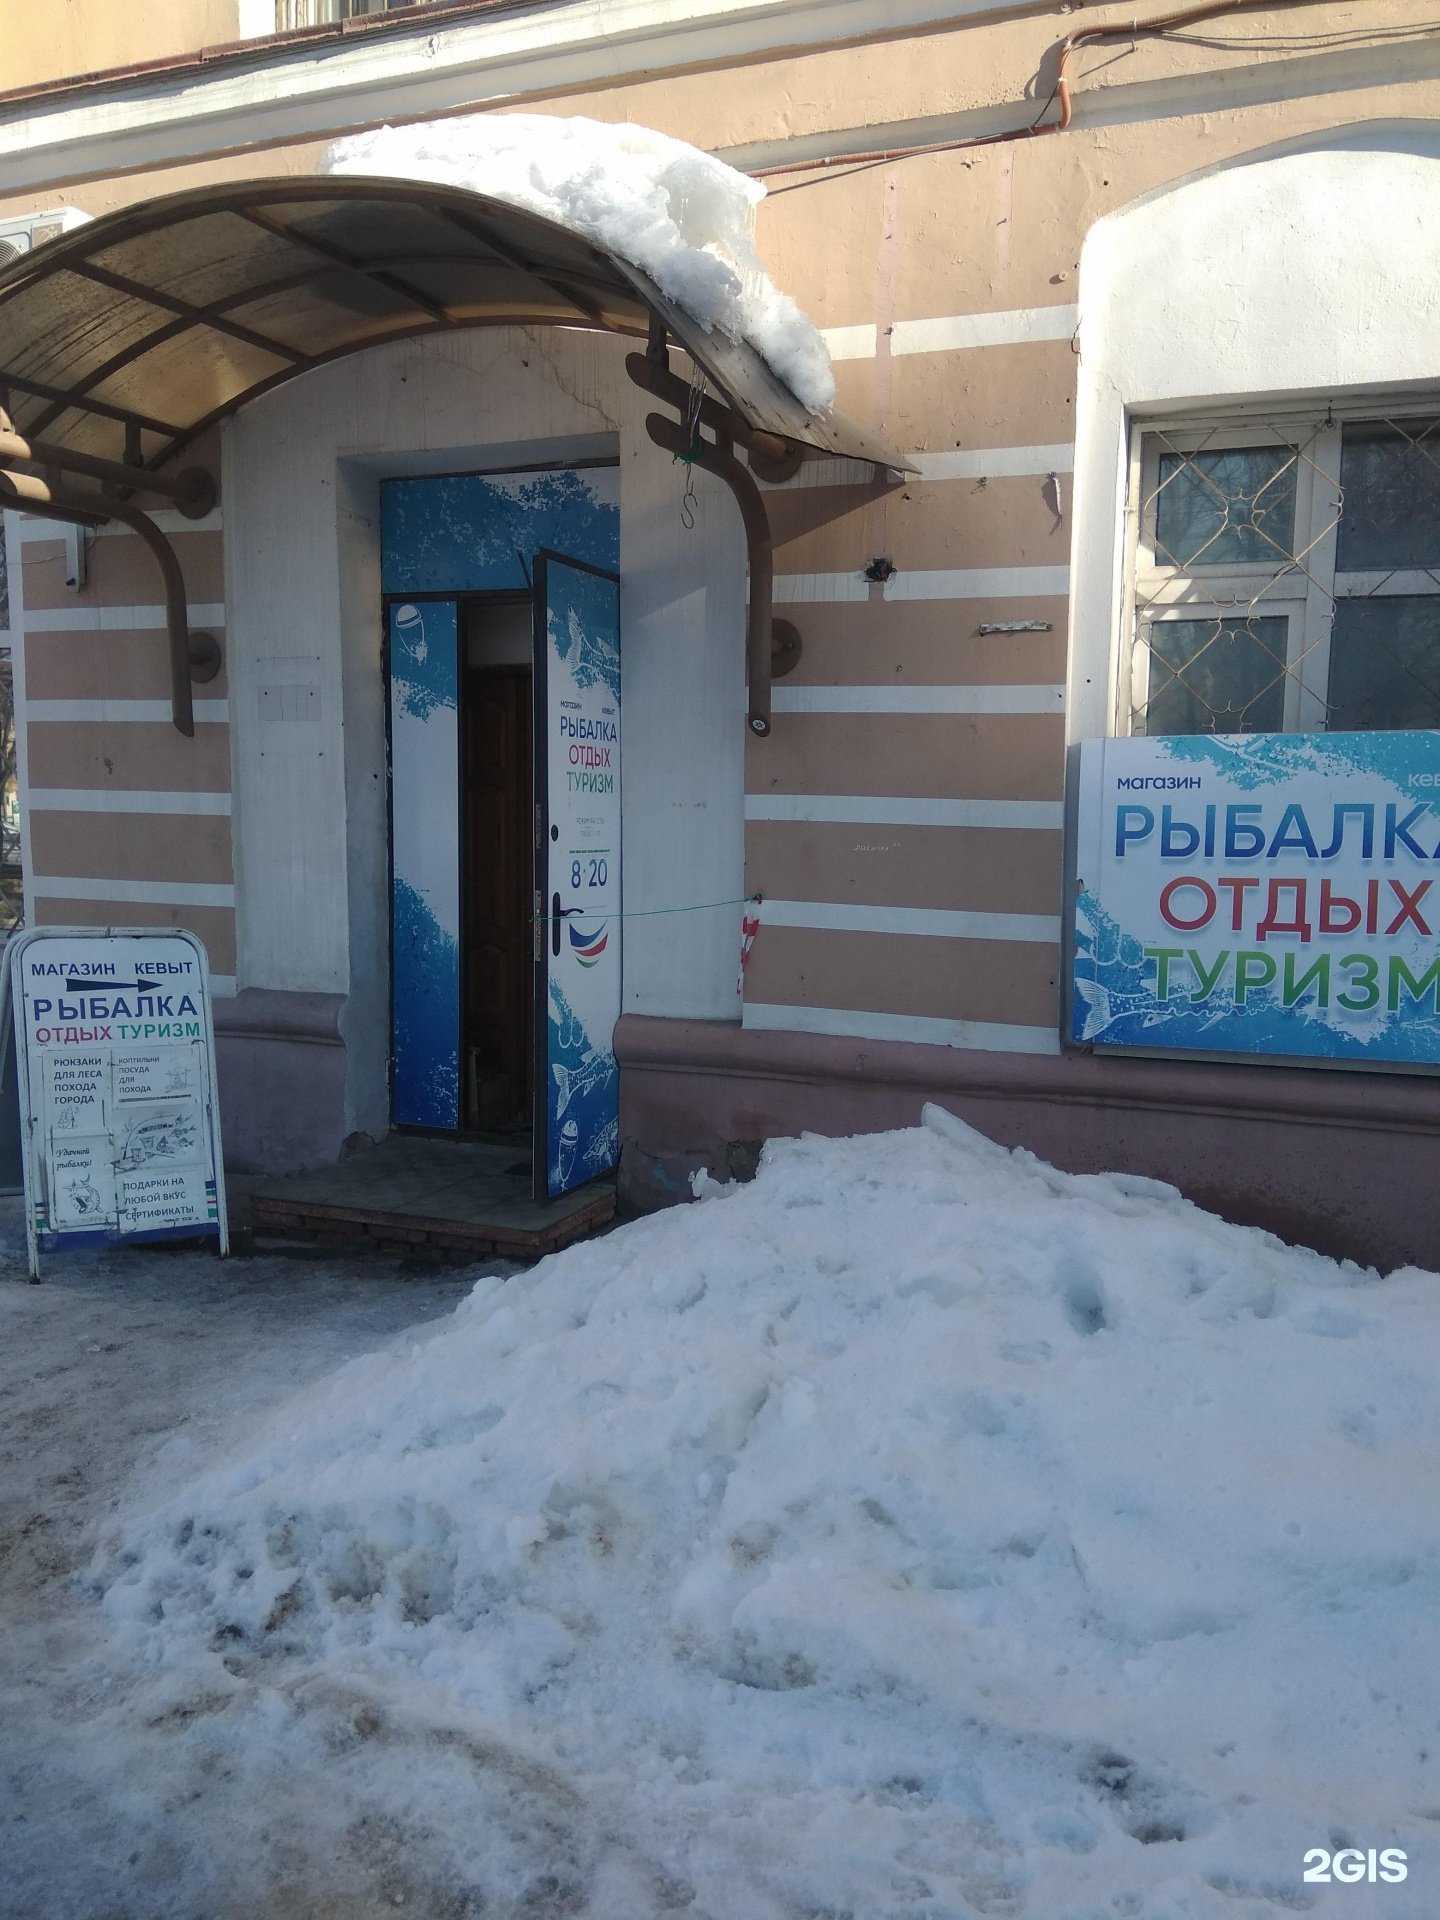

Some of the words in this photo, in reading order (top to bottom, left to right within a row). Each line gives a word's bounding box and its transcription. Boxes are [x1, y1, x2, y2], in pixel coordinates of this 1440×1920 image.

[560, 716, 617, 742] РЫБАЛКА
[569, 745, 611, 769] ОТДЫХ
[566, 771, 614, 793] ТУРИЗМ
[1117, 776, 1201, 790] магазин
[1115, 803, 1440, 859] РЫБАЛК
[1159, 876, 1434, 943] ОТДЫХ
[31, 963, 115, 976] МАГАЗИН
[134, 961, 192, 975] КЕВЫТ
[1144, 948, 1440, 1014] ТУРИЗМ
[33, 995, 198, 1021] РЫБАЛКА
[36, 1025, 112, 1045] ОТДЫХ
[117, 1022, 201, 1040] ТУРИЗМ
[54, 1057, 102, 1067] РЮКЗАКИ
[54, 1071, 75, 1081] ДЛЯ
[77, 1070, 103, 1079] ЛЕСА
[119, 1066, 150, 1074] ПОСУДА
[54, 1083, 97, 1093] ПОХОДА
[119, 1085, 152, 1094] ПОХОДА
[55, 1095, 95, 1105] ГОРОДА
[123, 1179, 169, 1191] ПОДАРКИ
[171, 1177, 185, 1186] НА
[124, 1192, 161, 1205] ЛЮБОЙ
[163, 1191, 186, 1201] ВКУС
[125, 1206, 194, 1221] СЕРТИФИКАТЫ
